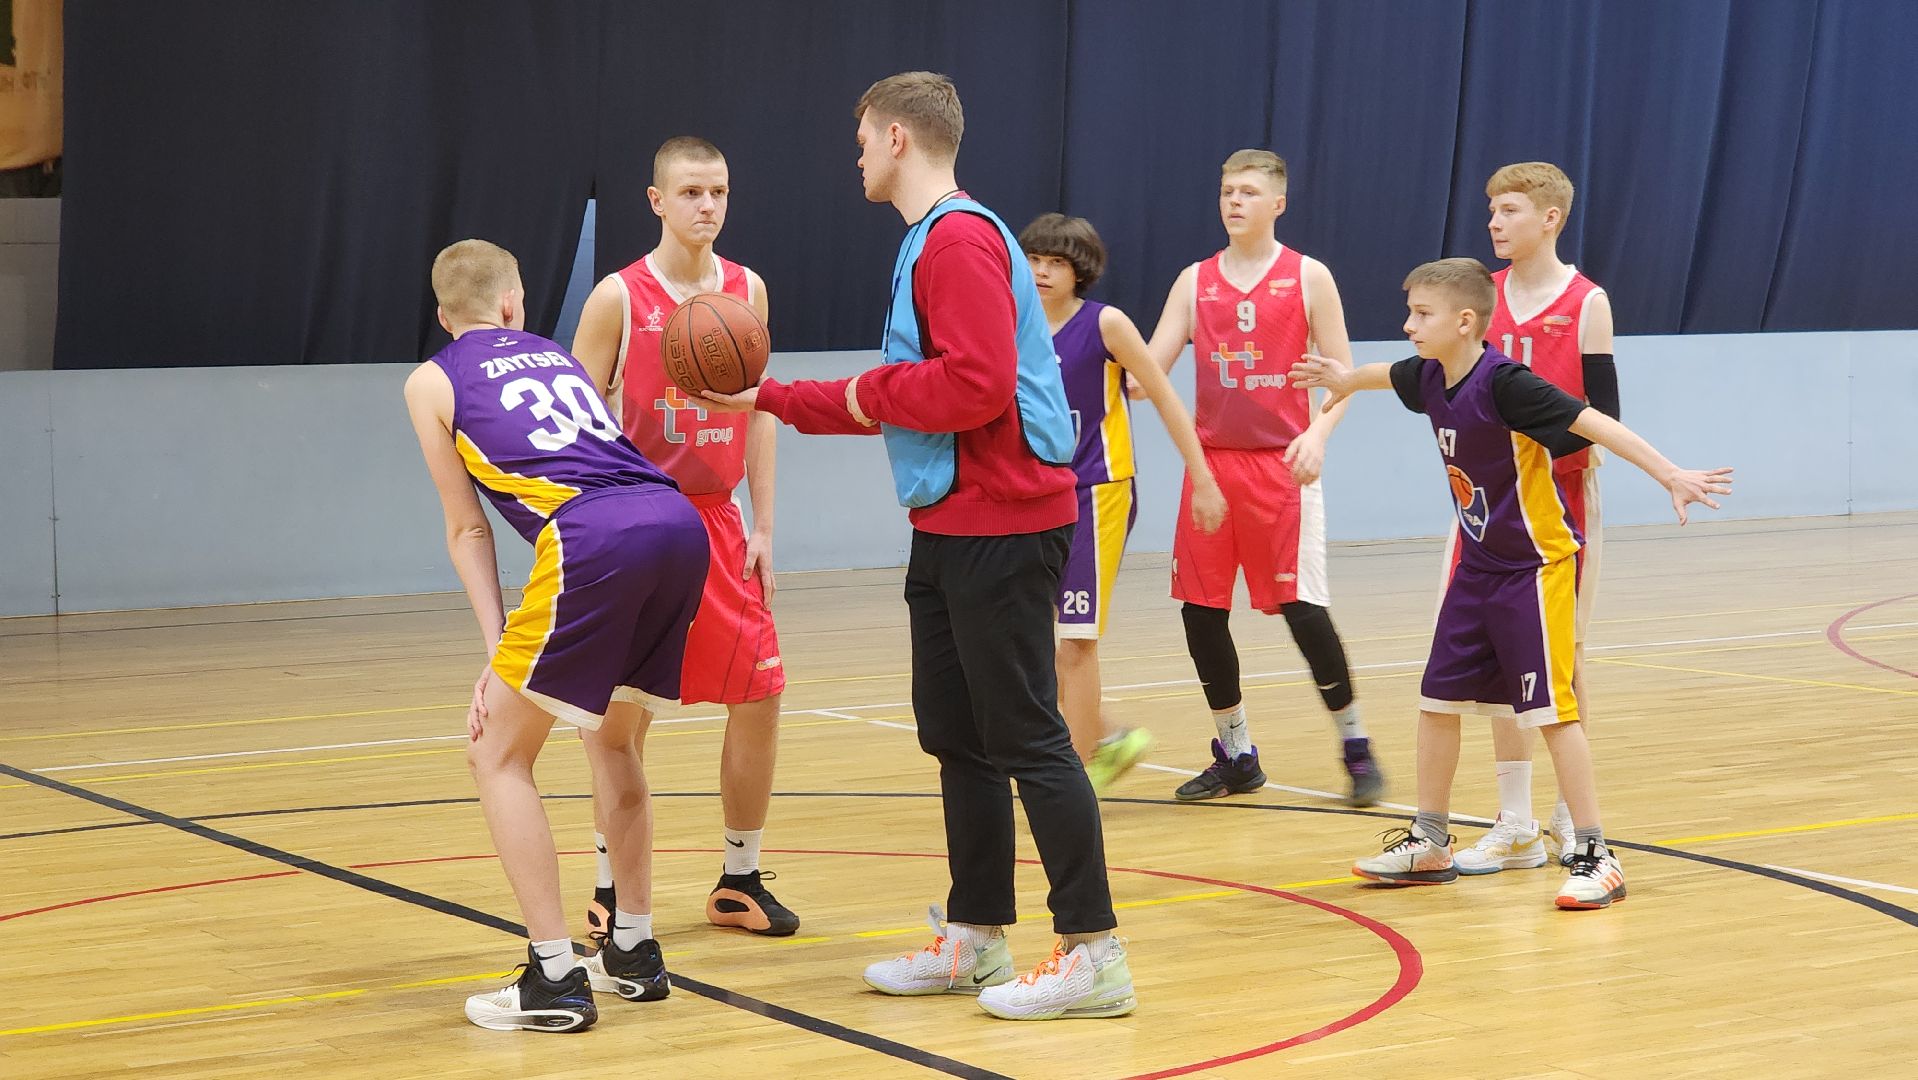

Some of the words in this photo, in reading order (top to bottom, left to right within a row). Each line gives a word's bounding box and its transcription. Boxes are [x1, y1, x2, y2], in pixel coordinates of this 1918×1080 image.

[1236, 300, 1256, 332] 9
[1501, 333, 1533, 368] 11
[1244, 374, 1287, 391] group
[500, 374, 623, 452] 30
[695, 426, 734, 447] group
[1063, 590, 1090, 615] 26
